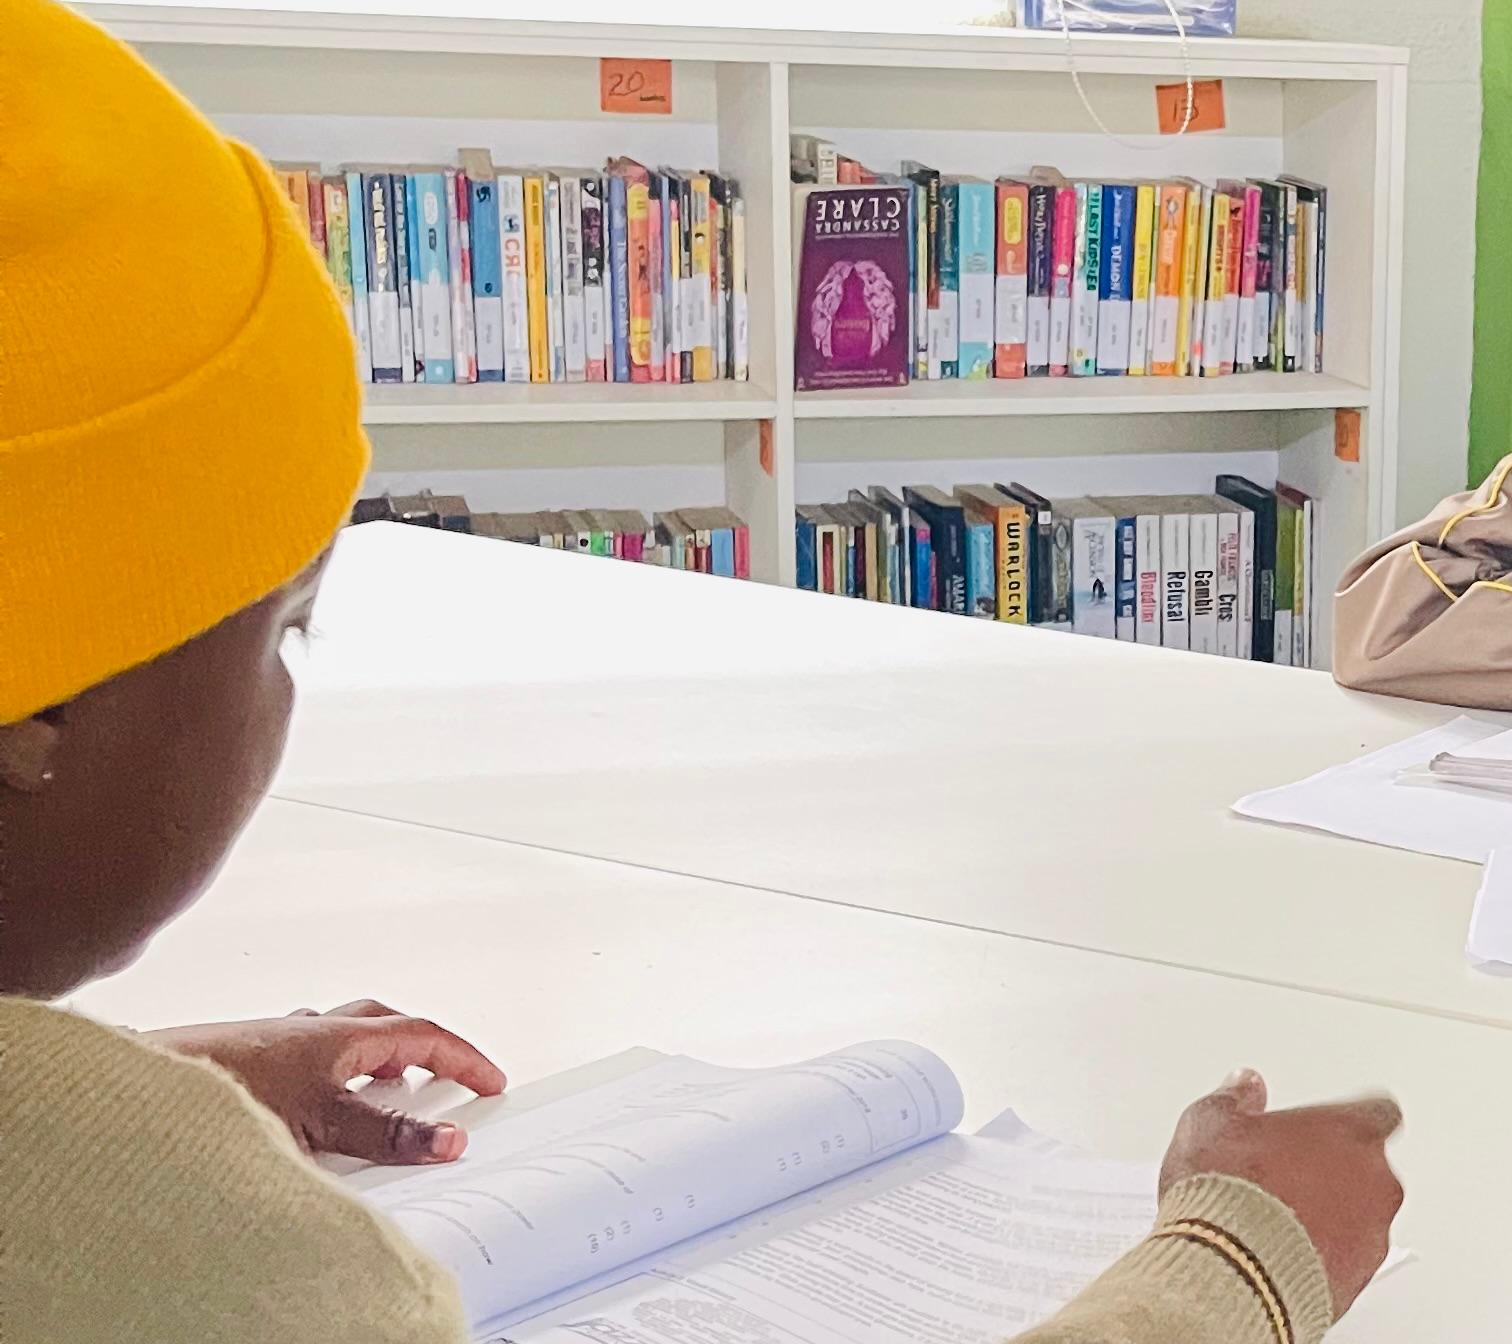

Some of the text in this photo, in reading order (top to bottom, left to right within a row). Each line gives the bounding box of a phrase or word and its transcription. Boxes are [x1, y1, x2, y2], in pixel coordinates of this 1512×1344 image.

[815, 197, 901, 221] CLARE
[815, 219, 900, 234] CASSANDRA
[1006, 521, 1022, 618] WARLOCK
